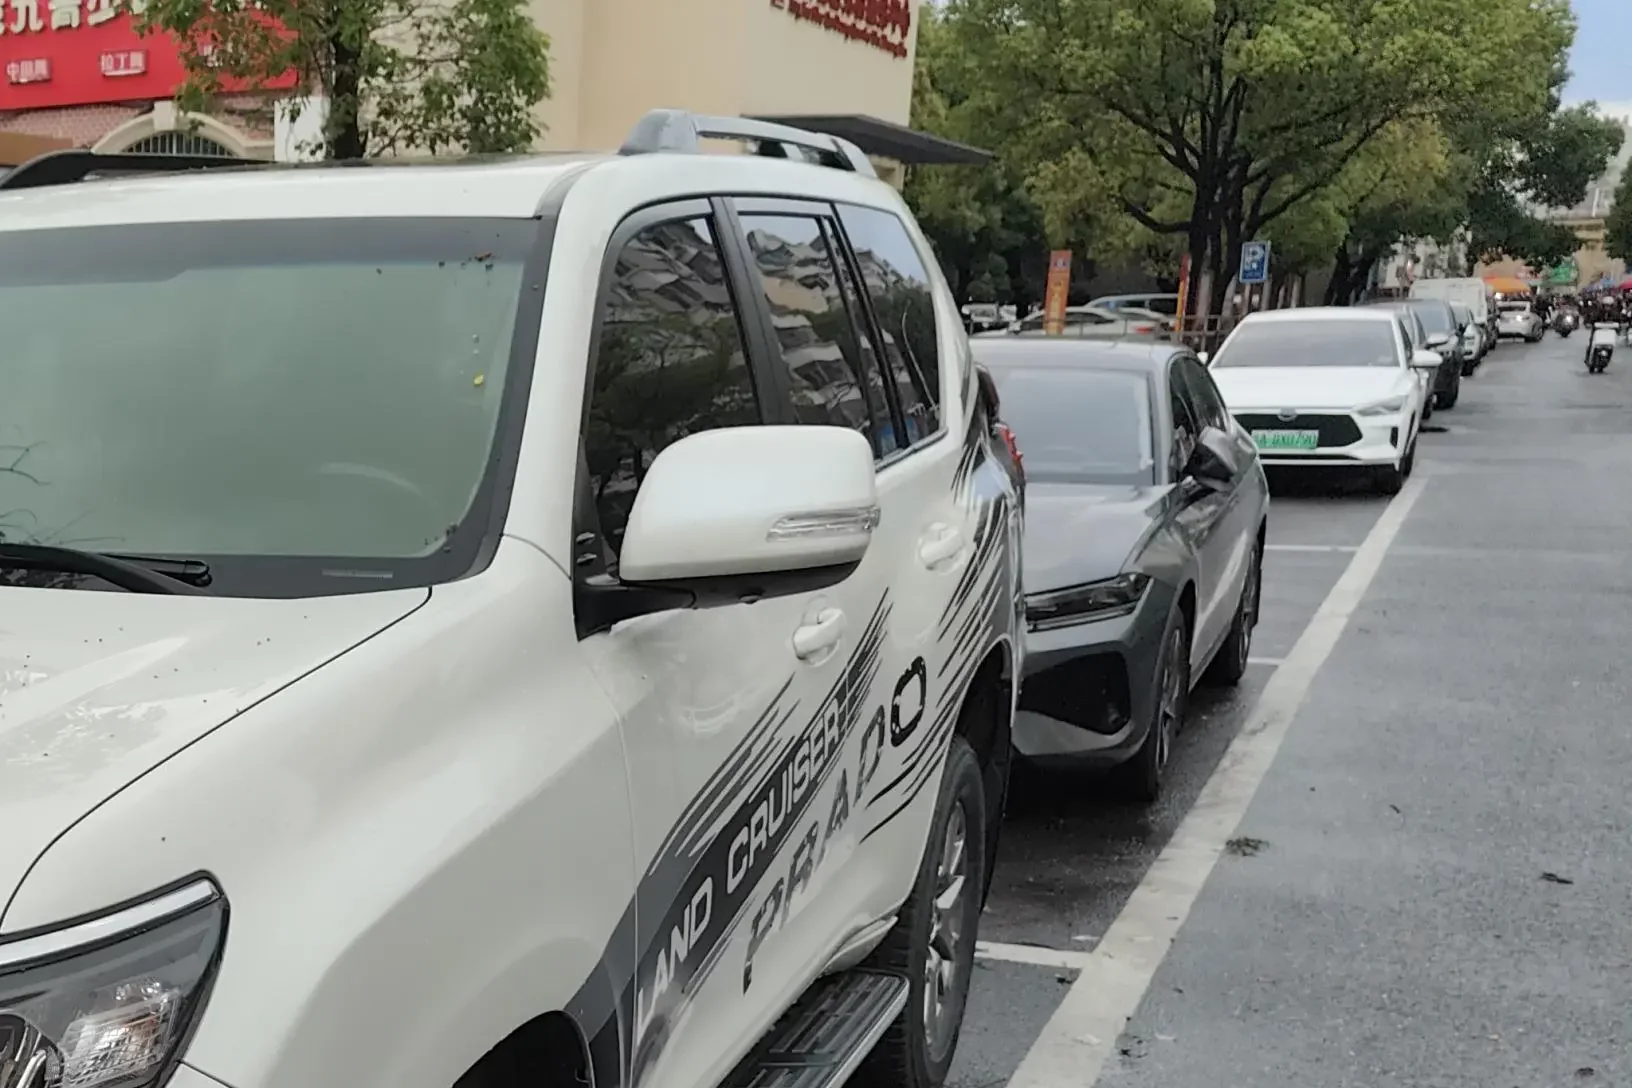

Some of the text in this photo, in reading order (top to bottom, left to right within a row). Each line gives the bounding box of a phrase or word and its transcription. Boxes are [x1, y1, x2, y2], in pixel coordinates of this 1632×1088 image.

[635, 697, 841, 1046] LAND CRUISER
[741, 655, 928, 998] PRADO
